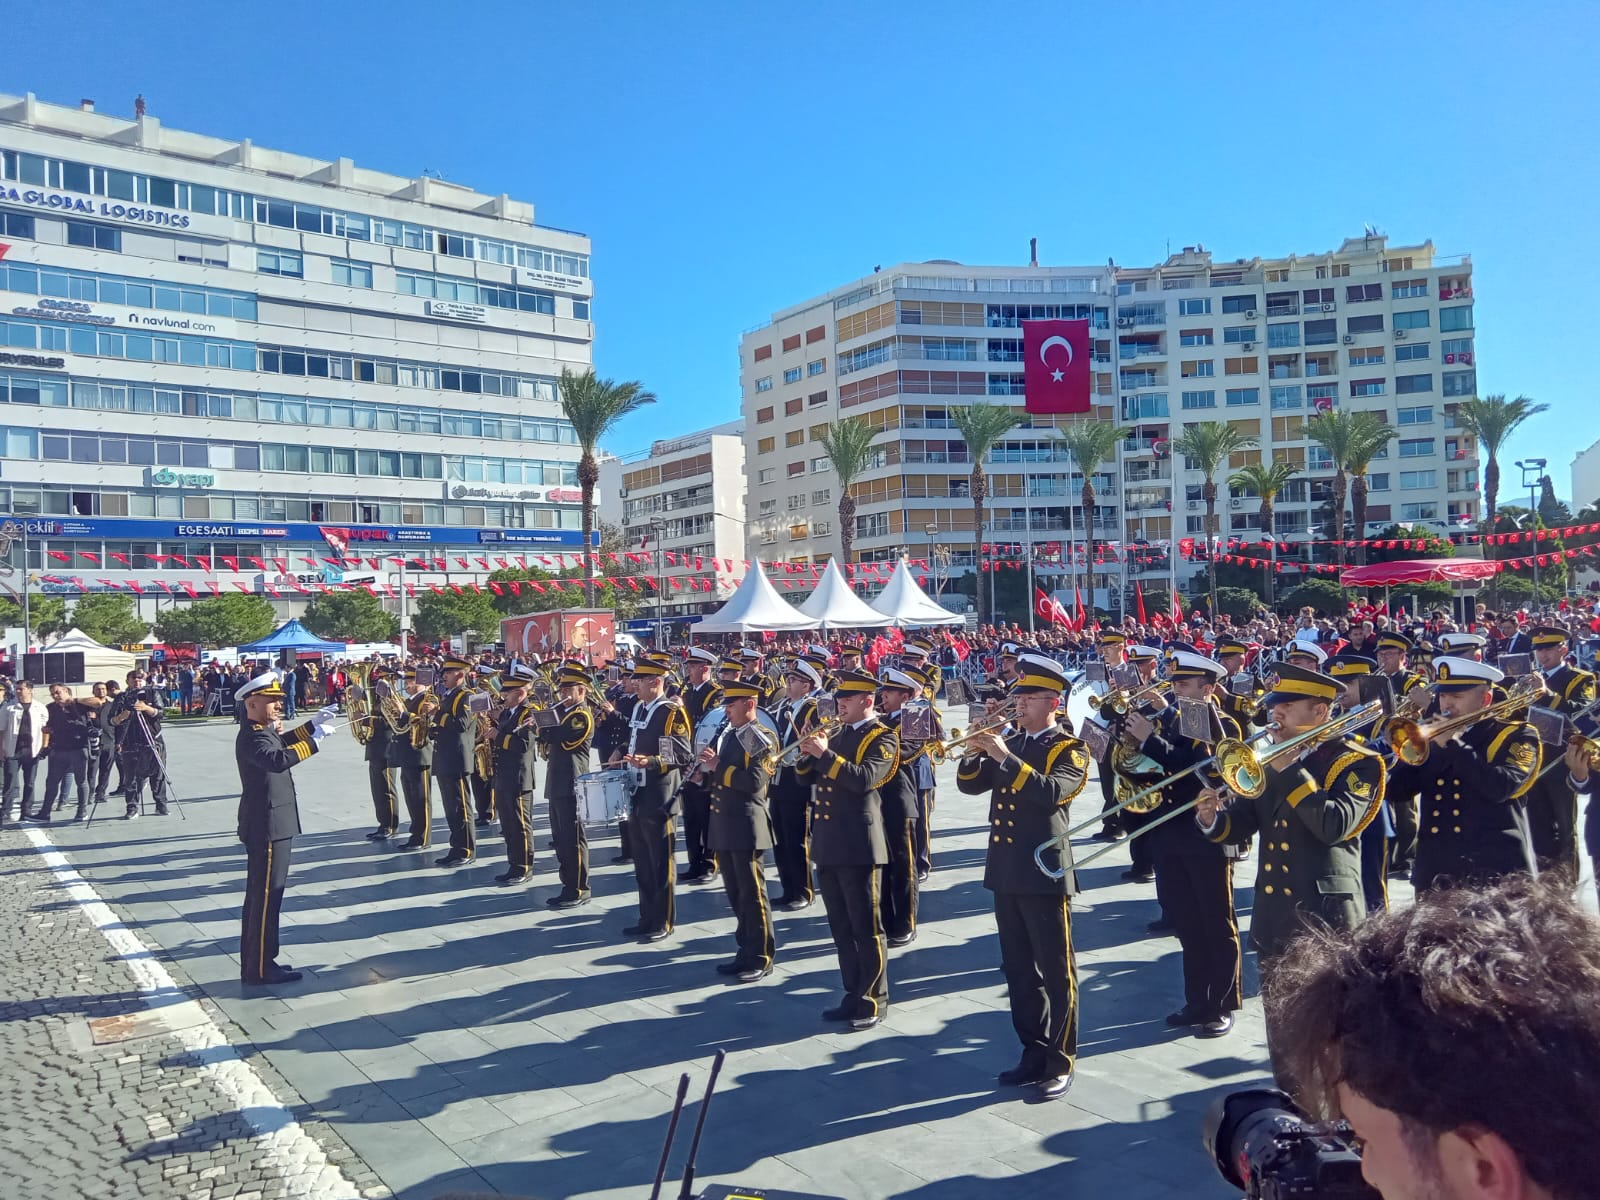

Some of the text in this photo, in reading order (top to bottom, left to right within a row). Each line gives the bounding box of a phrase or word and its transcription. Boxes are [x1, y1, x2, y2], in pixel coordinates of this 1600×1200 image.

[23, 190, 95, 213] GLOBAL
[101, 203, 190, 228] LOGISTICS
[154, 650, 162, 660] P
